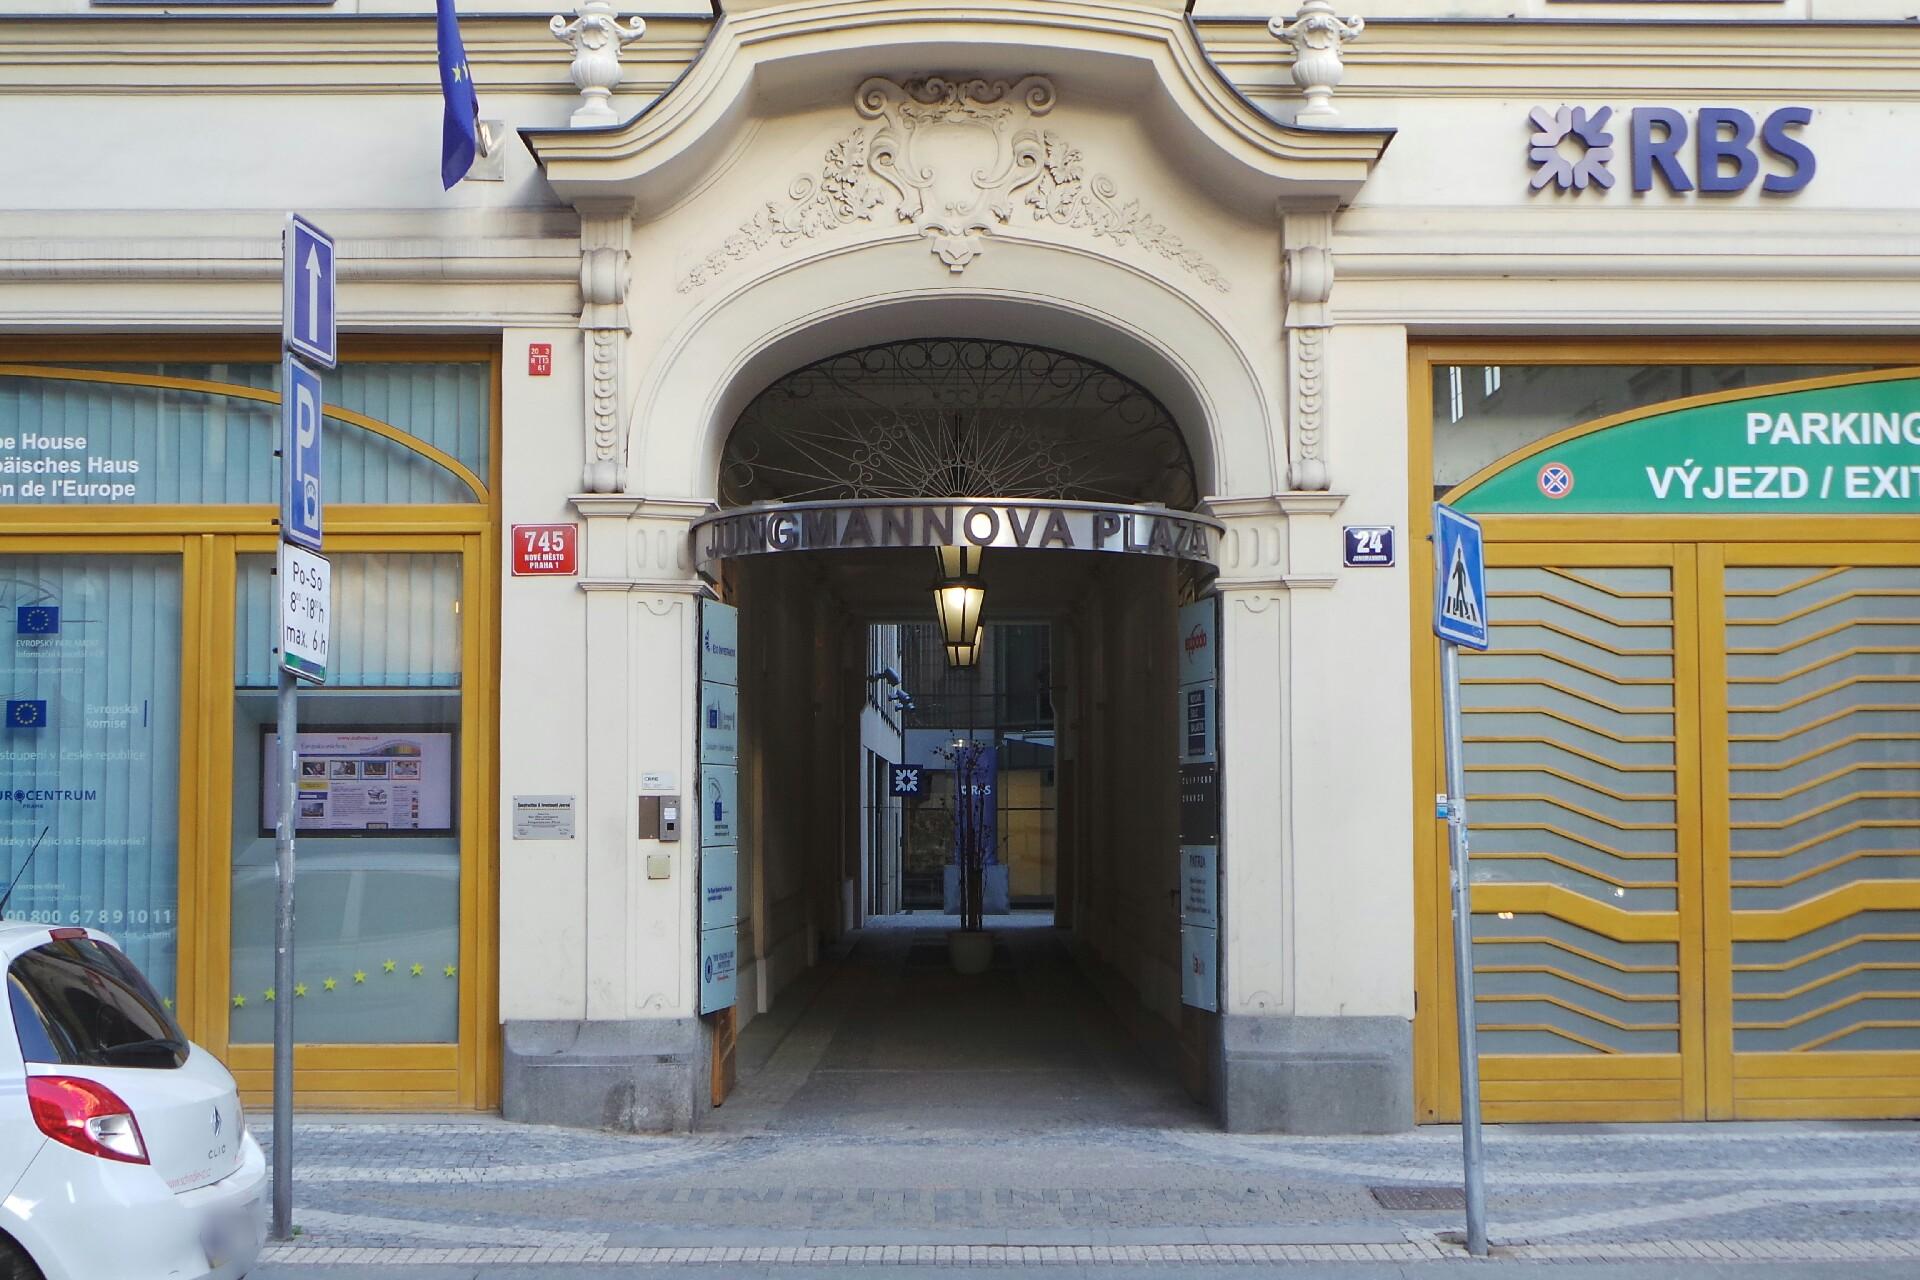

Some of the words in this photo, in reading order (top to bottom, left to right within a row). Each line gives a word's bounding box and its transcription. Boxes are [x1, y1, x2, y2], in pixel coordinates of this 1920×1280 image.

[1631, 106, 1817, 194] RBS
[296, 382, 316, 483] P
[1746, 411, 1920, 446] PARKING
[22, 433, 88, 450] House
[88, 456, 140, 474] Haus
[1645, 458, 1809, 499] VÝJEZD
[1819, 465, 1834, 499] /
[0, 483, 15, 497] n
[21, 479, 46, 497] de
[52, 479, 136, 500] l'Europe
[524, 531, 564, 552] 745
[705, 505, 1075, 560] JUNGMANNOVA
[1092, 510, 1210, 560] PLAZA
[1353, 530, 1383, 553] 24
[524, 552, 542, 561] NOVÉ
[542, 552, 564, 561] MĚSTO
[529, 561, 553, 569] PRAHA
[555, 561, 559, 569] 1
[292, 560, 323, 592] Po-So
[286, 625, 308, 649] max.
[312, 629, 319, 651] 6
[319, 633, 326, 656] h
[86, 718, 128, 729] komise
[30, 908, 62, 924] 800
[208, 1144, 226, 1160] CLIO
